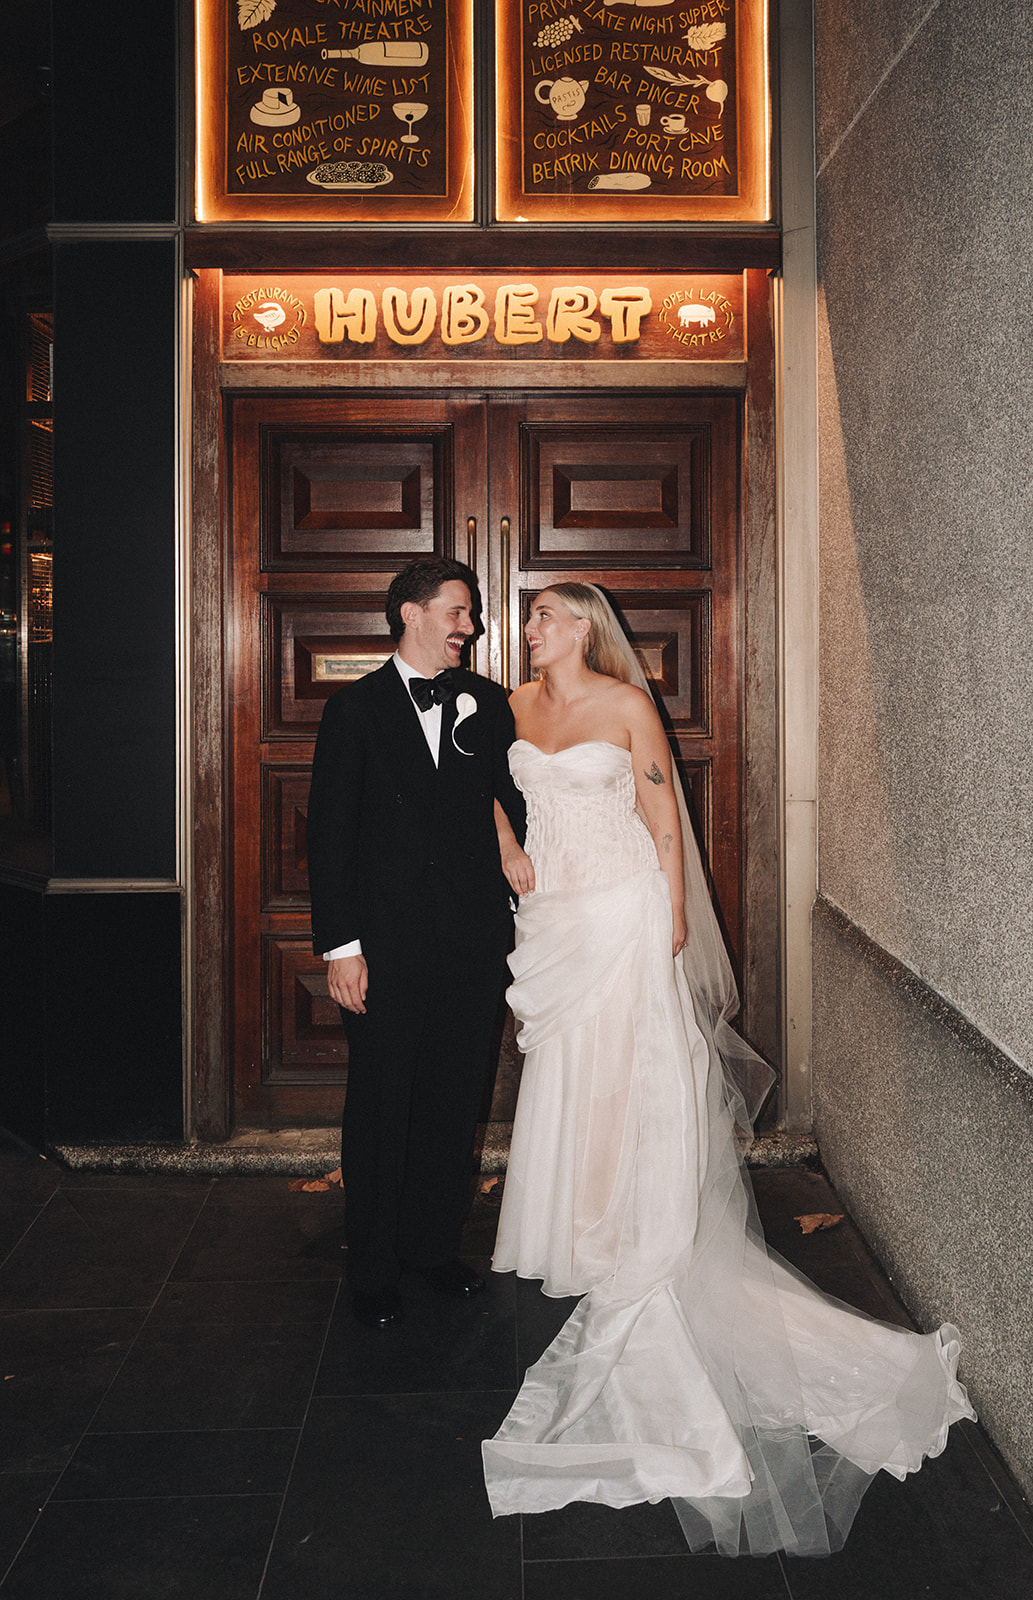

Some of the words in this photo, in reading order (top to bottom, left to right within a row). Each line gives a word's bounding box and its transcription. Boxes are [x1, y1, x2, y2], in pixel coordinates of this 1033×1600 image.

[253, 24, 327, 52] ROYALE
[339, 14, 431, 40] THEATRE
[584, 1, 625, 31] LATE
[631, 14, 673, 34] NIGHT
[679, 0, 730, 28] SUPPER
[531, 44, 602, 75] LICENSED
[611, 43, 722, 68] RESTAURANT
[238, 61, 338, 86] EXTENSIVE
[345, 72, 386, 96] WINE
[393, 73, 429, 95] LIST
[595, 66, 631, 92] BAR
[636, 80, 699, 114] PINCER
[237, 133, 268, 153] AIR
[273, 104, 380, 147] CONDITIONED
[534, 105, 626, 149] COCKTAILS
[623, 128, 675, 152] PORT
[679, 124, 724, 151] CAVE
[236, 159, 276, 184] FULL
[277, 142, 331, 172] RANGE
[334, 137, 352, 152] OF
[357, 138, 430, 166] SPIRITS
[533, 152, 599, 183] BEATRIX
[610, 151, 674, 179] DINING
[681, 153, 731, 180] ROOM
[235, 287, 304, 315] RESTAURANT
[314, 283, 652, 345] HUBERT
[663, 288, 693, 309] OPEN
[699, 288, 731, 312] LATE
[666, 323, 726, 346] THEATRE
